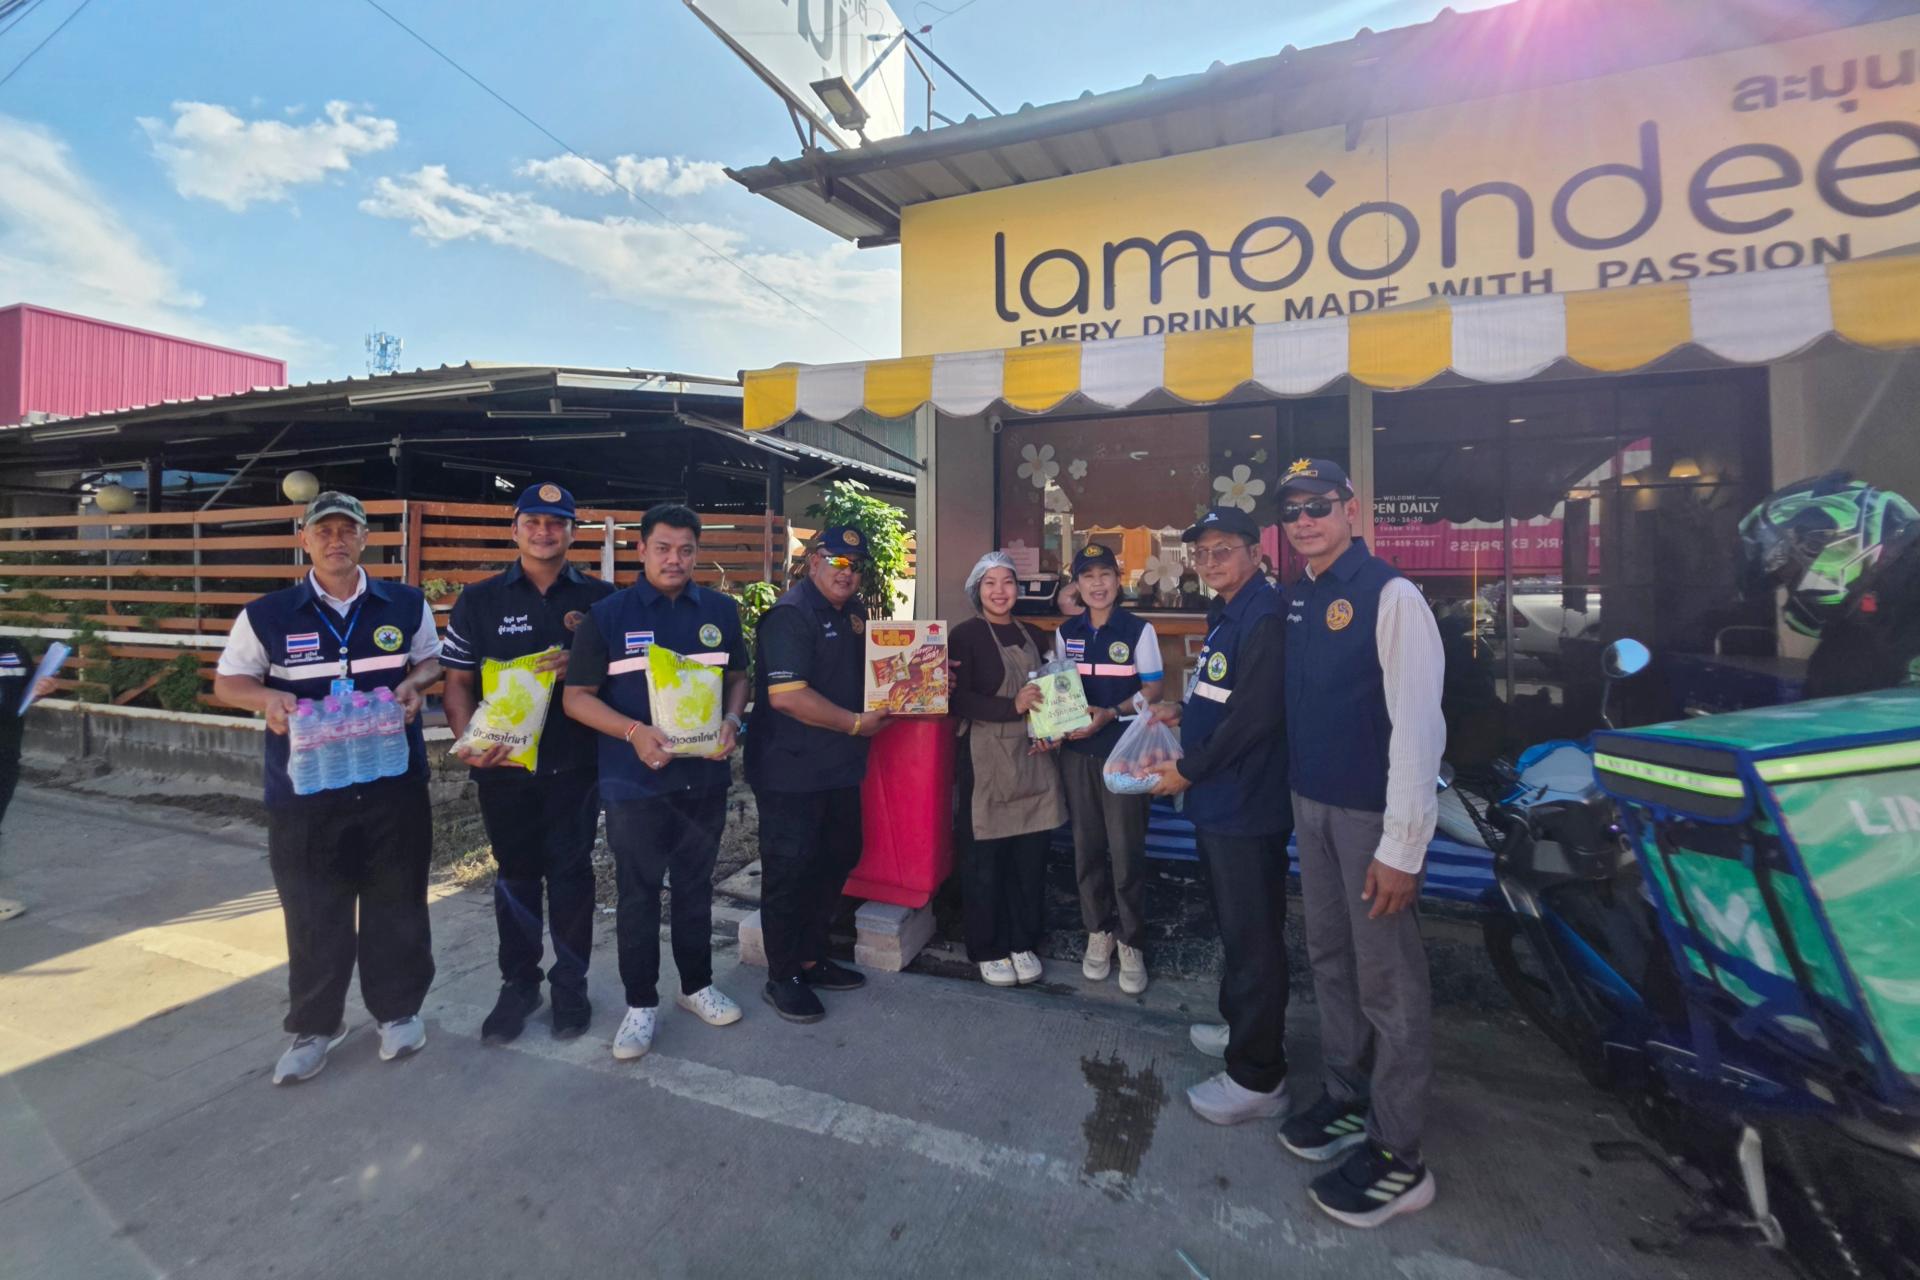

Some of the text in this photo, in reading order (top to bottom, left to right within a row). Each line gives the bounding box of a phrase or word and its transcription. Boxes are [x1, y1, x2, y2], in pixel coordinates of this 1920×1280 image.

[994, 120, 1920, 323] lamoondee
[1143, 303, 1257, 336] DRINK
[1284, 286, 1399, 321] MADE
[1597, 233, 1851, 288] PASSION
[1371, 502, 1439, 514] PEN DAILY
